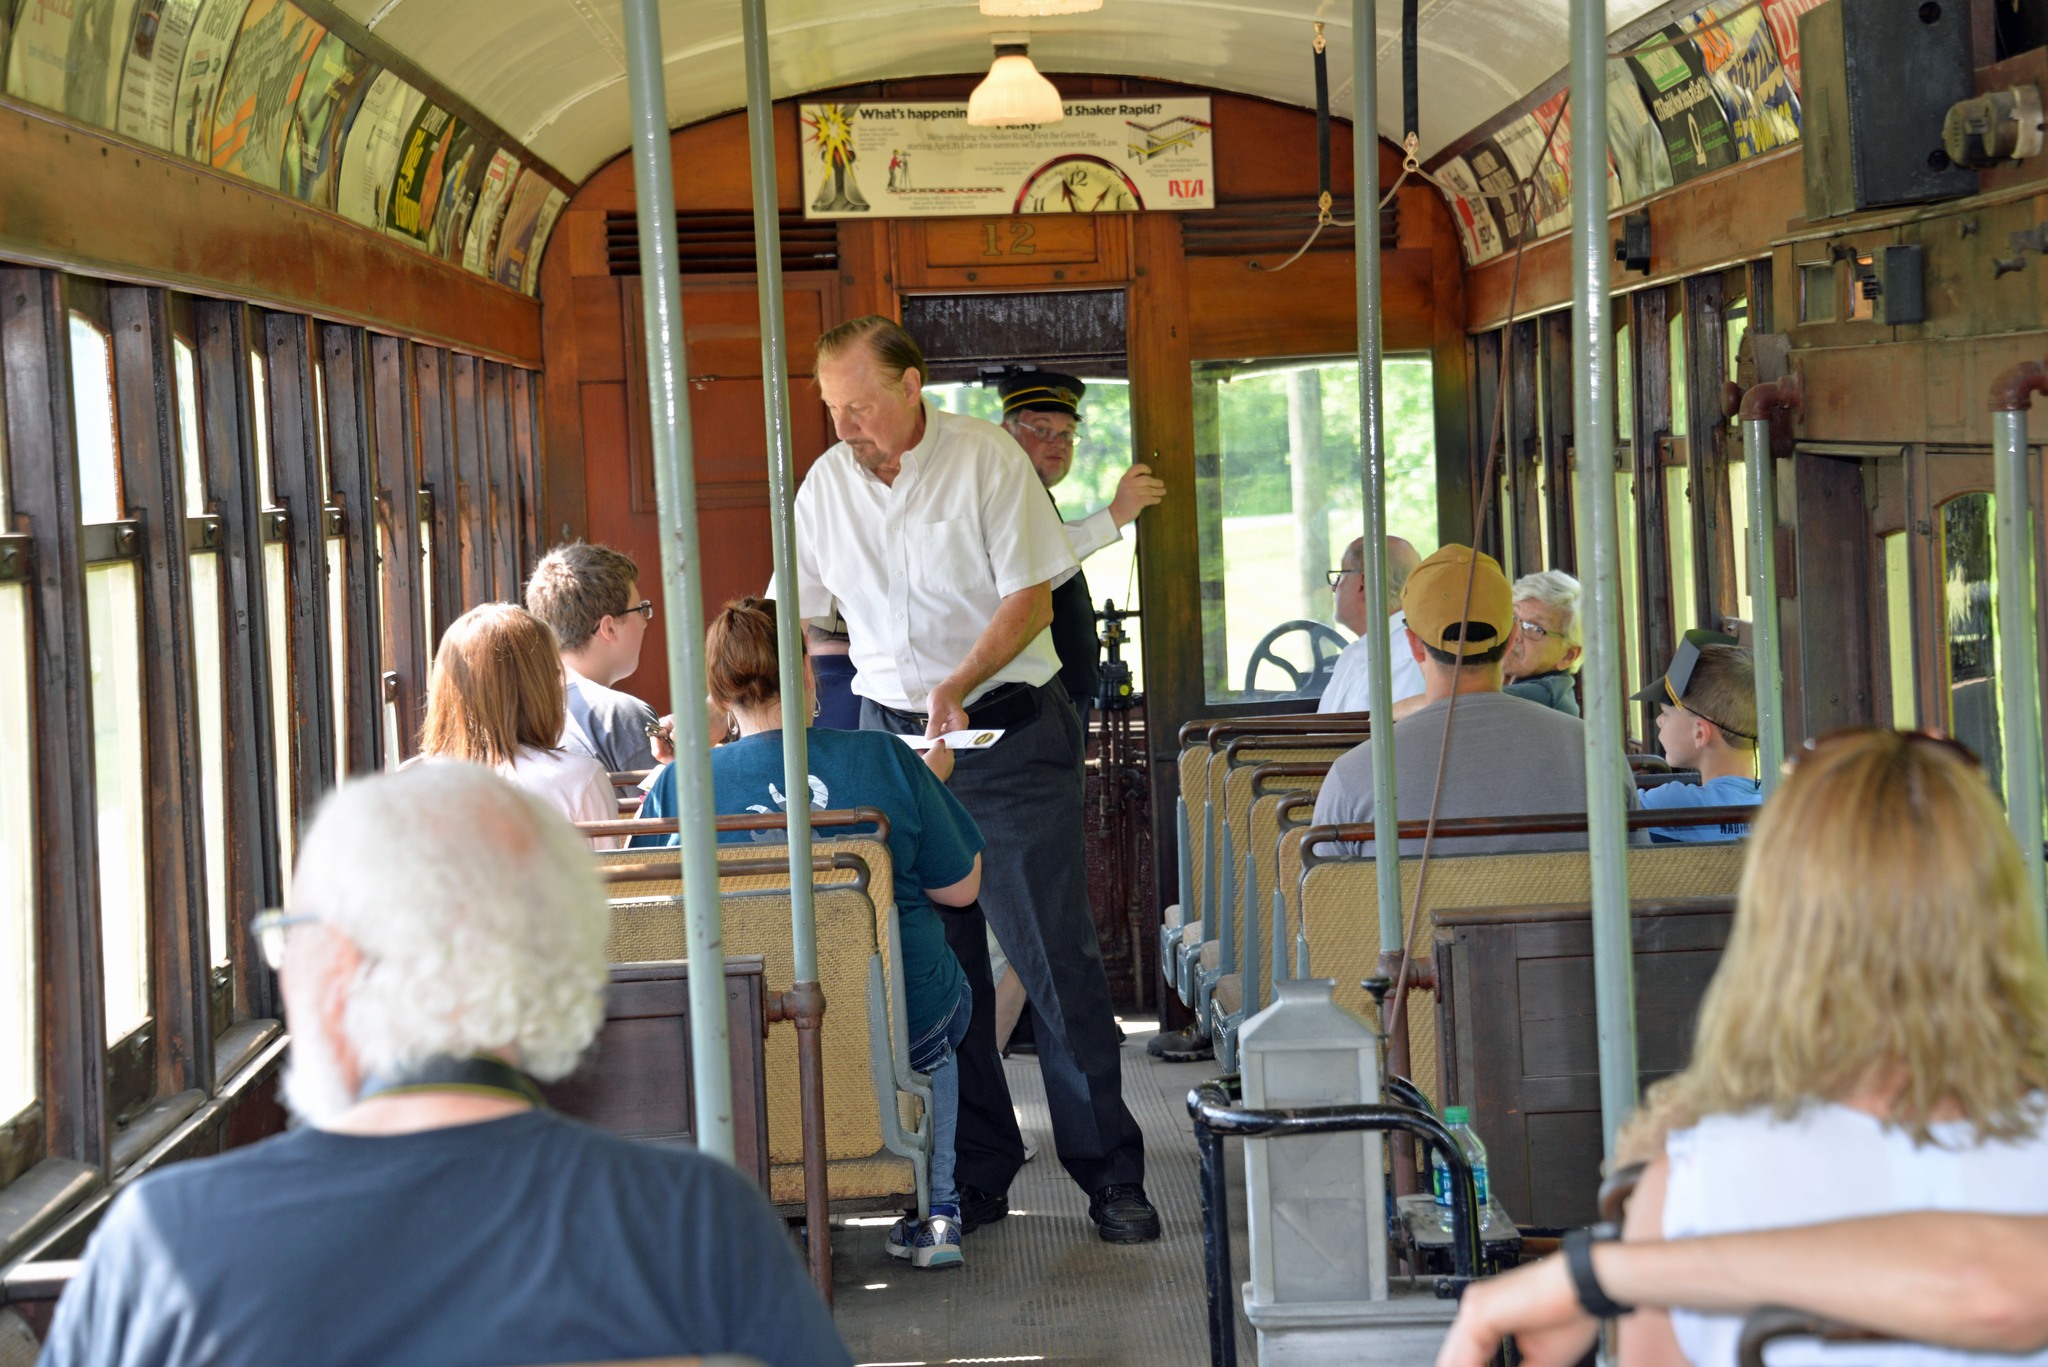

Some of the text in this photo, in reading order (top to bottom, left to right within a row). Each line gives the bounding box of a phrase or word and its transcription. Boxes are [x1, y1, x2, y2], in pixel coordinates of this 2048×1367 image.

[859, 108, 967, 121] What's happenin
[1075, 105, 1117, 116] Shaker
[1119, 103, 1162, 117] Rapid?
[1069, 170, 1087, 187] 12
[1168, 180, 1204, 198] RTA
[1033, 197, 1045, 213] 11
[982, 223, 1036, 256] 12
